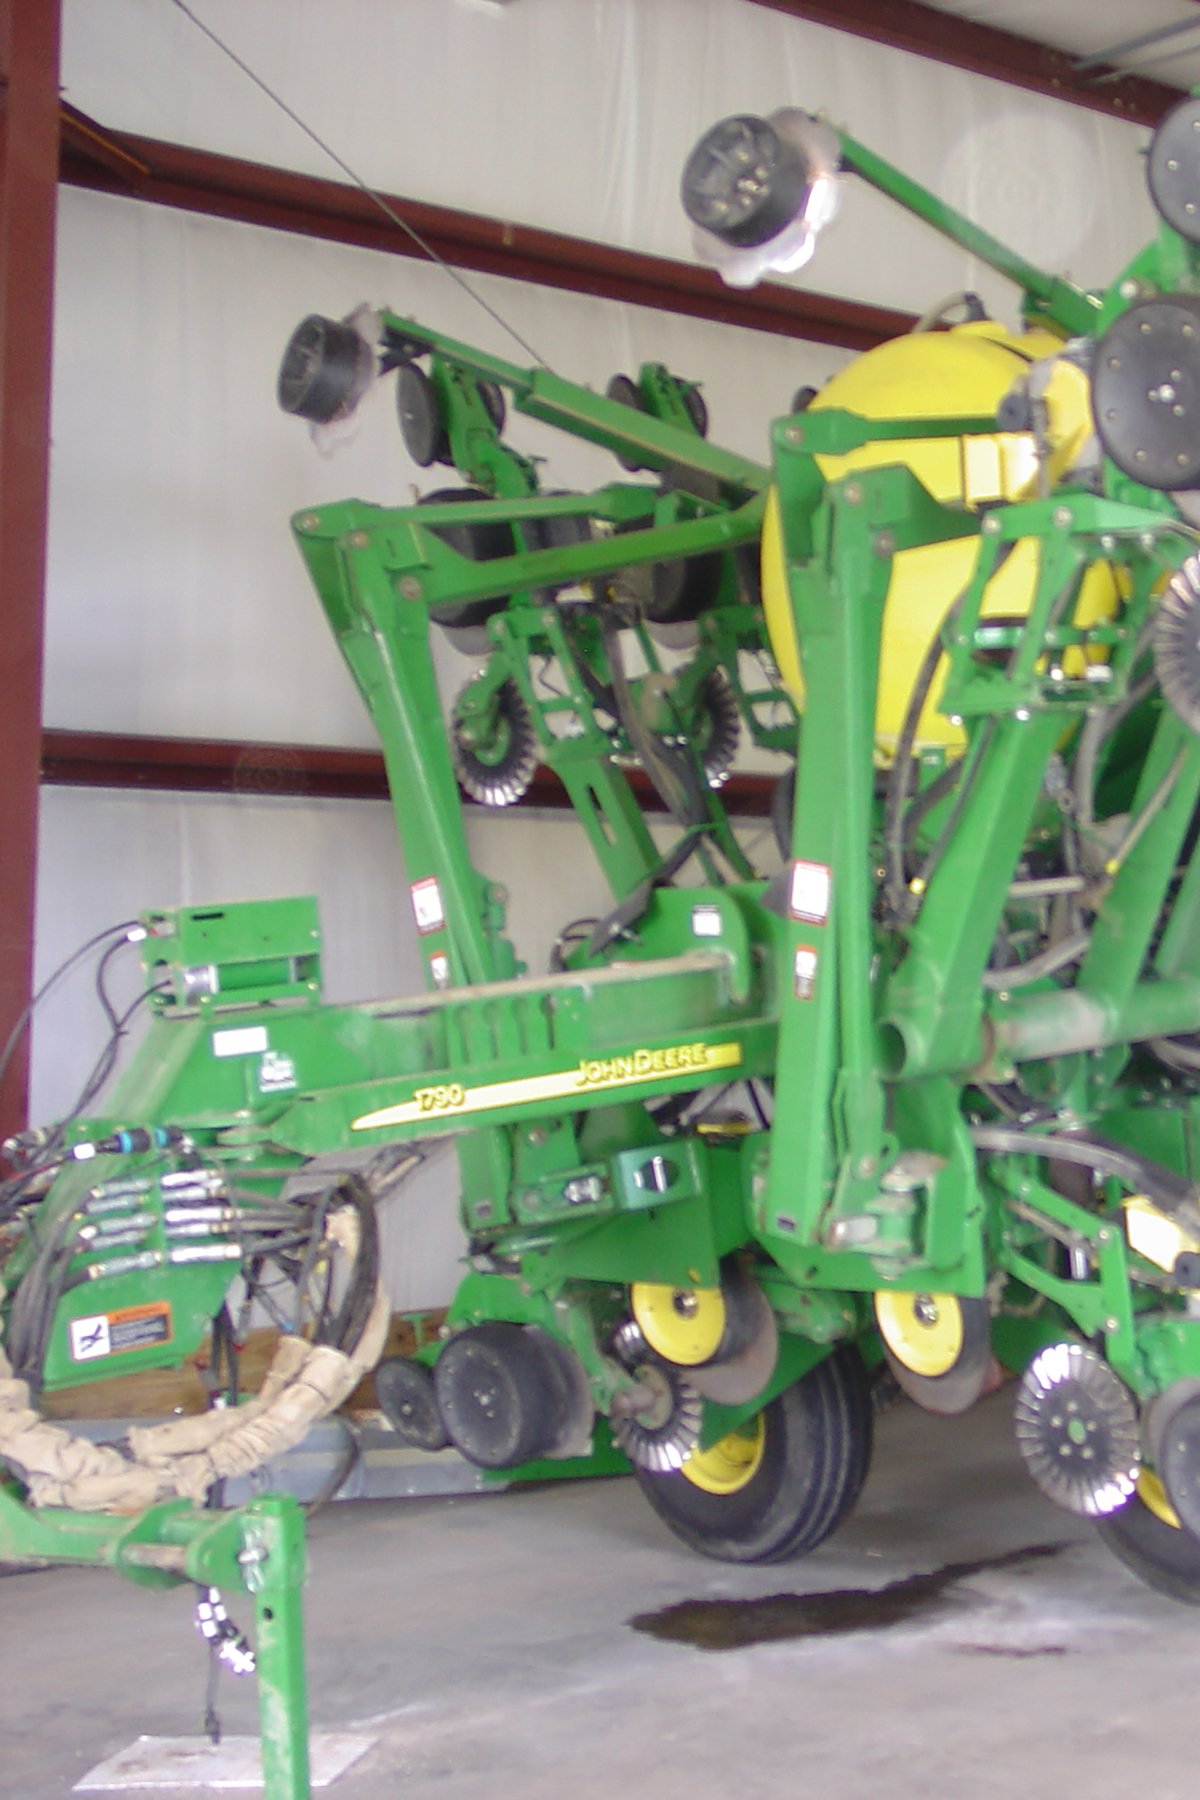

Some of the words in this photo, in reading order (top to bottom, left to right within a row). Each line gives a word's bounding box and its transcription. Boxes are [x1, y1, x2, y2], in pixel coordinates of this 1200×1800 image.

[576, 1057, 632, 1086] JOHN
[632, 1043, 707, 1075] DEERE
[414, 1083, 465, 1111] 1790
